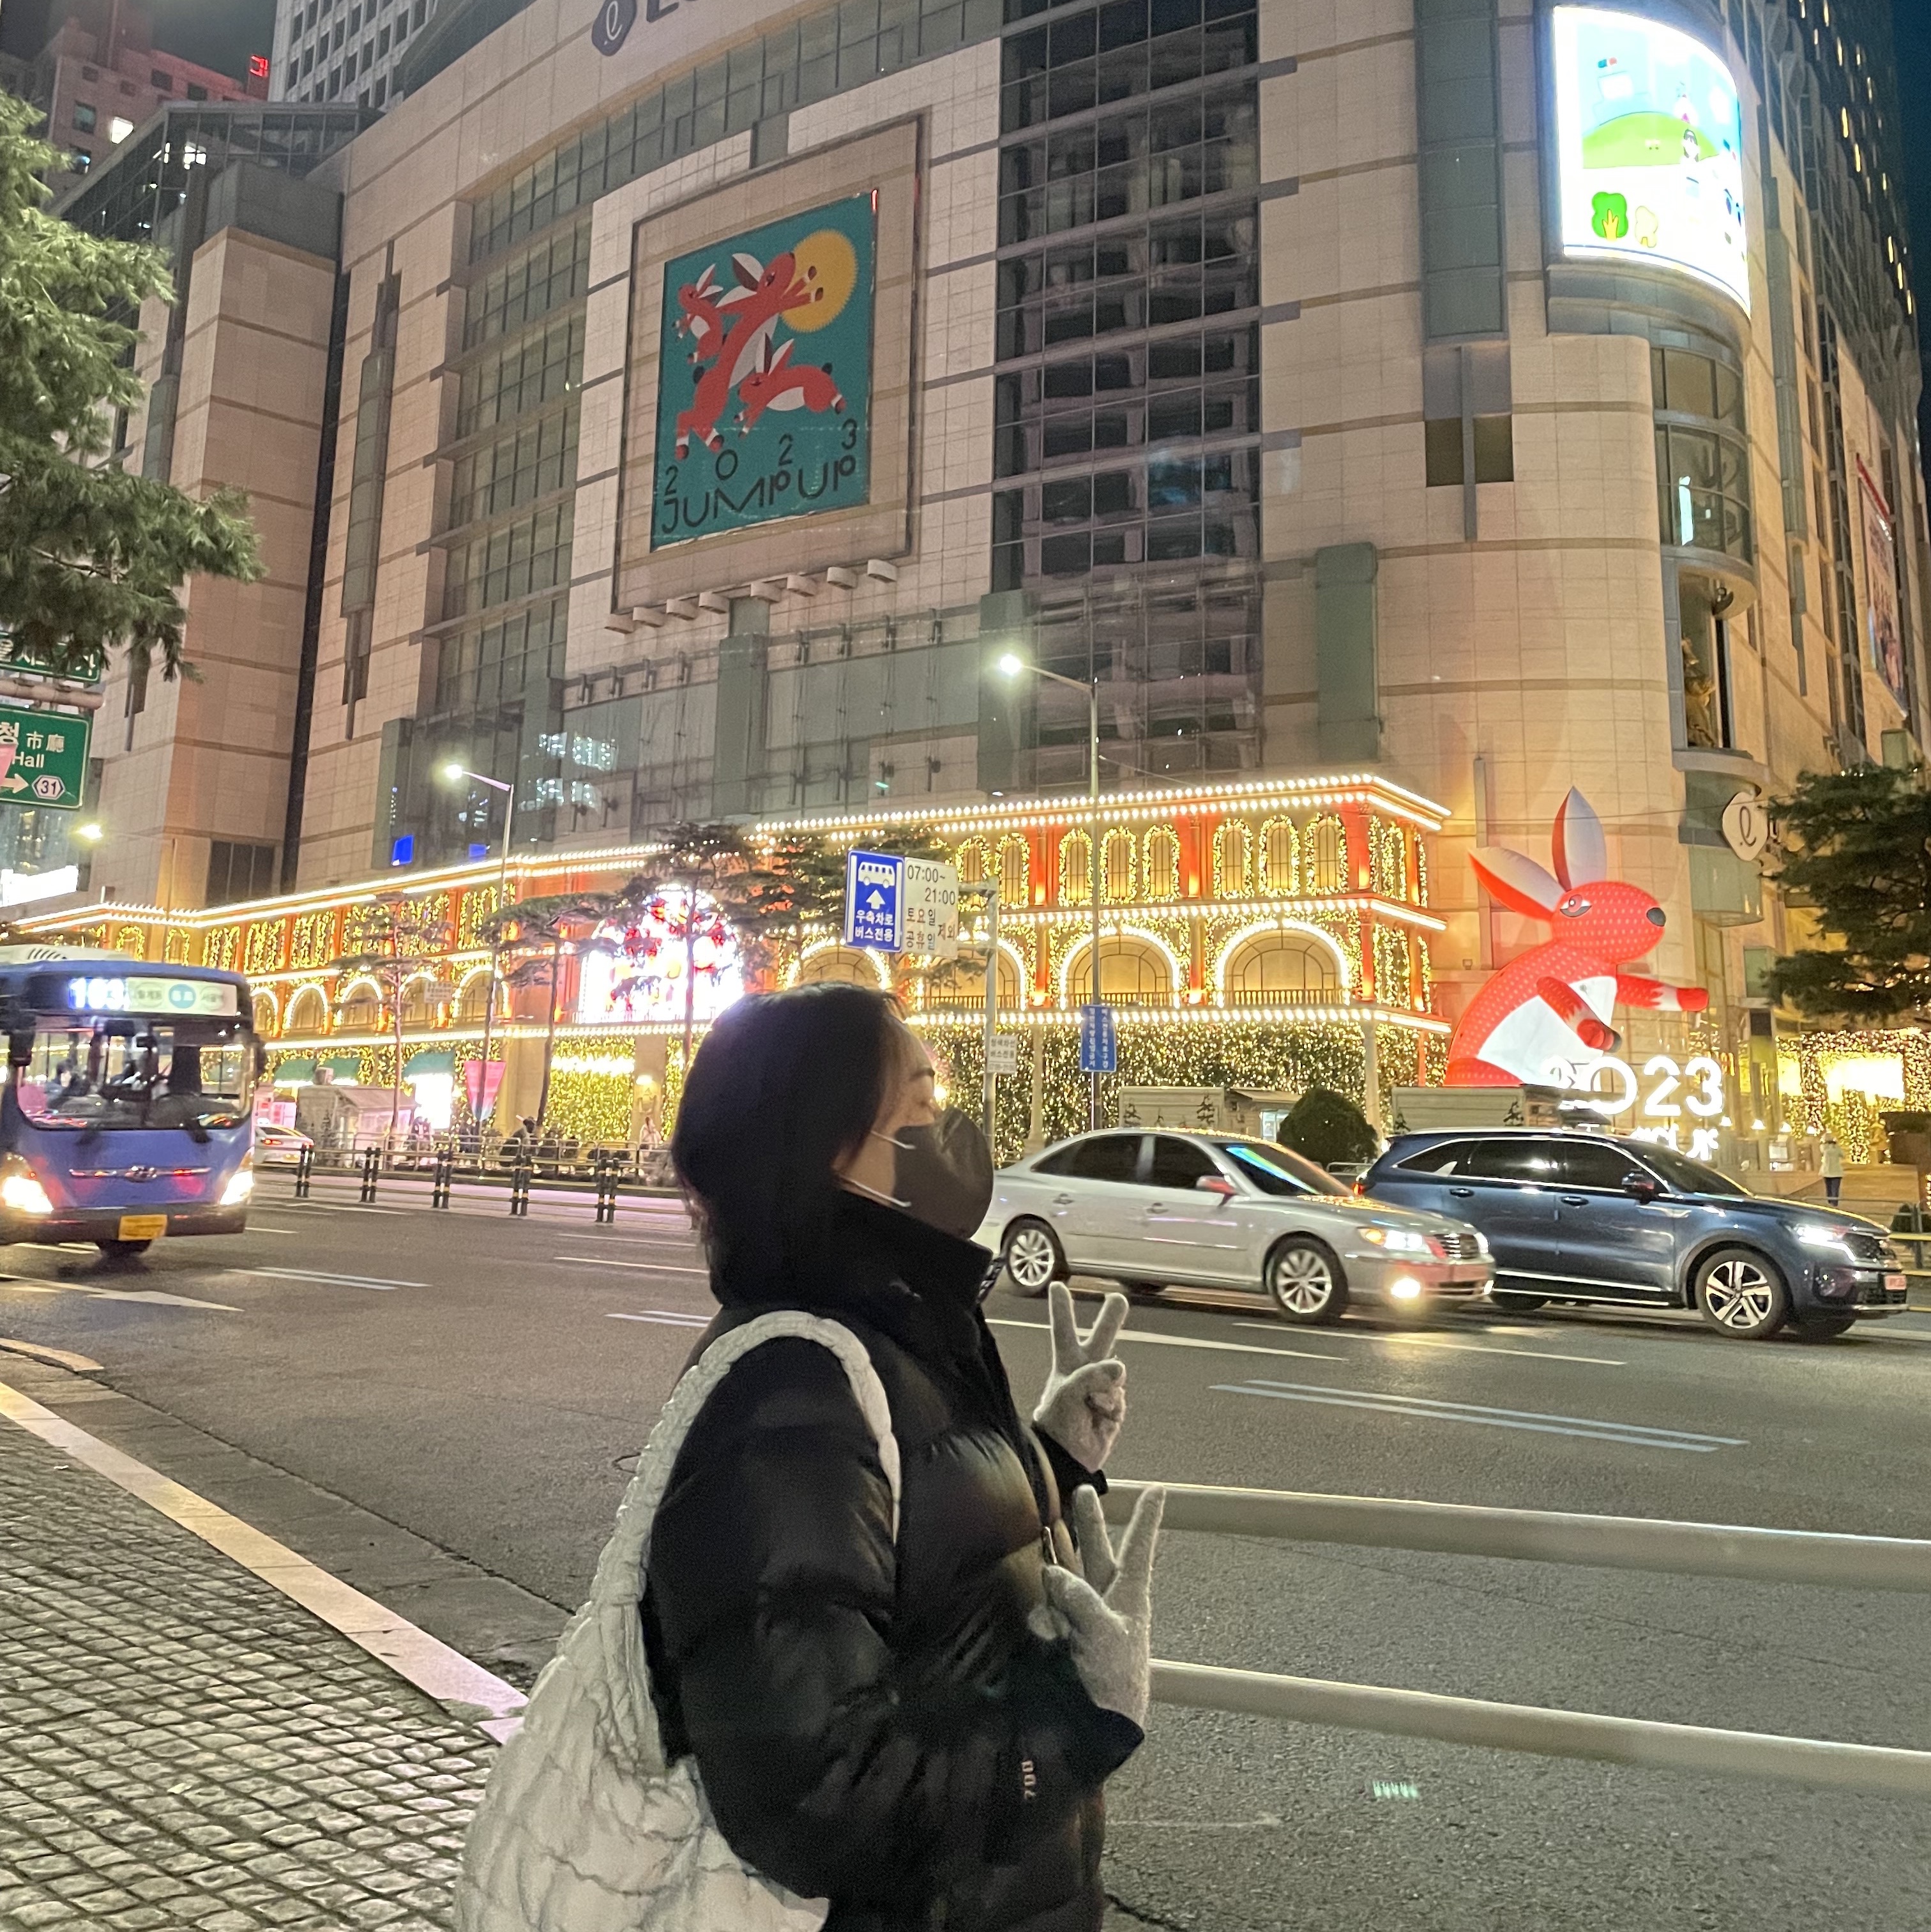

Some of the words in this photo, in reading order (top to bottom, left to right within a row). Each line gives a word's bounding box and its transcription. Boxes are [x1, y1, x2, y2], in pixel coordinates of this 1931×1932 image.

[663, 418, 857, 496] 2023
[12, 751, 45, 768] Hall
[41, 780, 57, 795] 31
[907, 865, 946, 883] 07:00~
[925, 887, 956, 905] 21:00
[856, 909, 894, 926] 우측차로
[906, 908, 935, 926] 토요일
[854, 925, 894, 942] 버스전용
[905, 931, 935, 950] 공휴일
[937, 923, 955, 941] 제외
